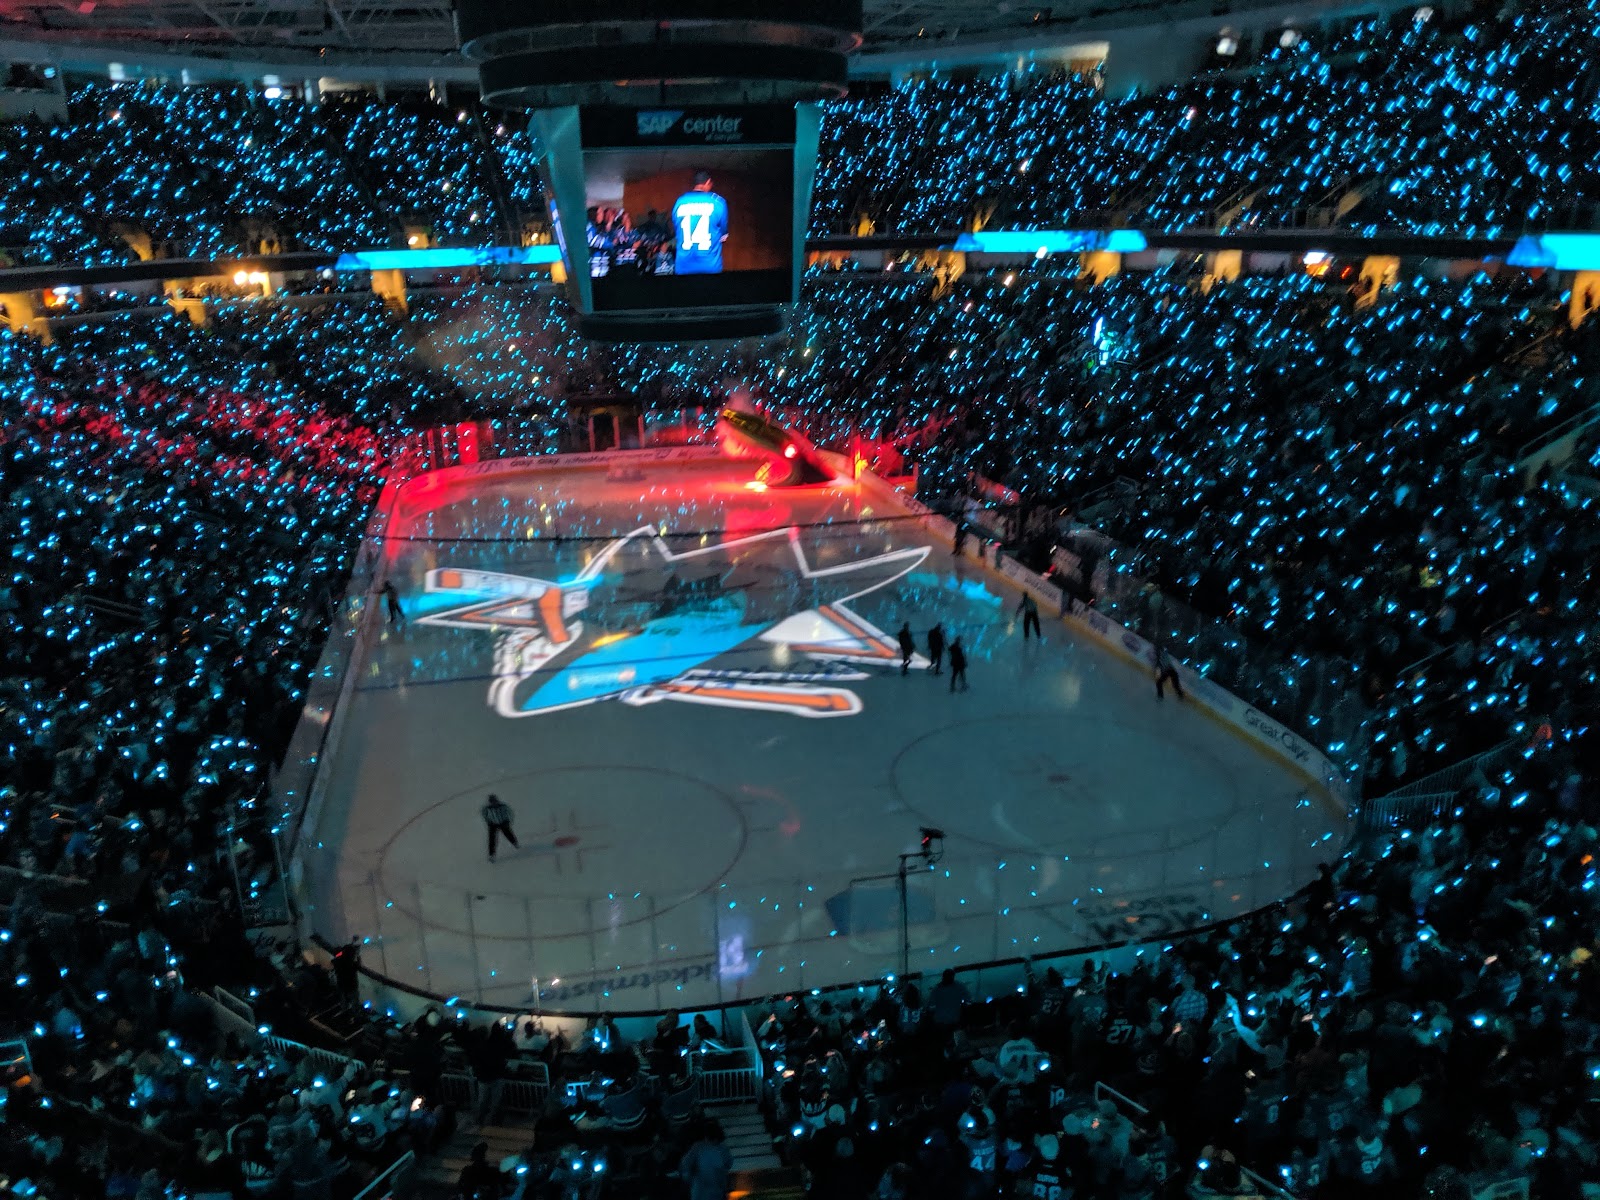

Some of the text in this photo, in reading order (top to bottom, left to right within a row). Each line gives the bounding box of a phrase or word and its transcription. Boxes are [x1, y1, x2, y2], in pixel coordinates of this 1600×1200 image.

[637, 113, 743, 135] SAP center
[1106, 1024, 1134, 1045] 27
